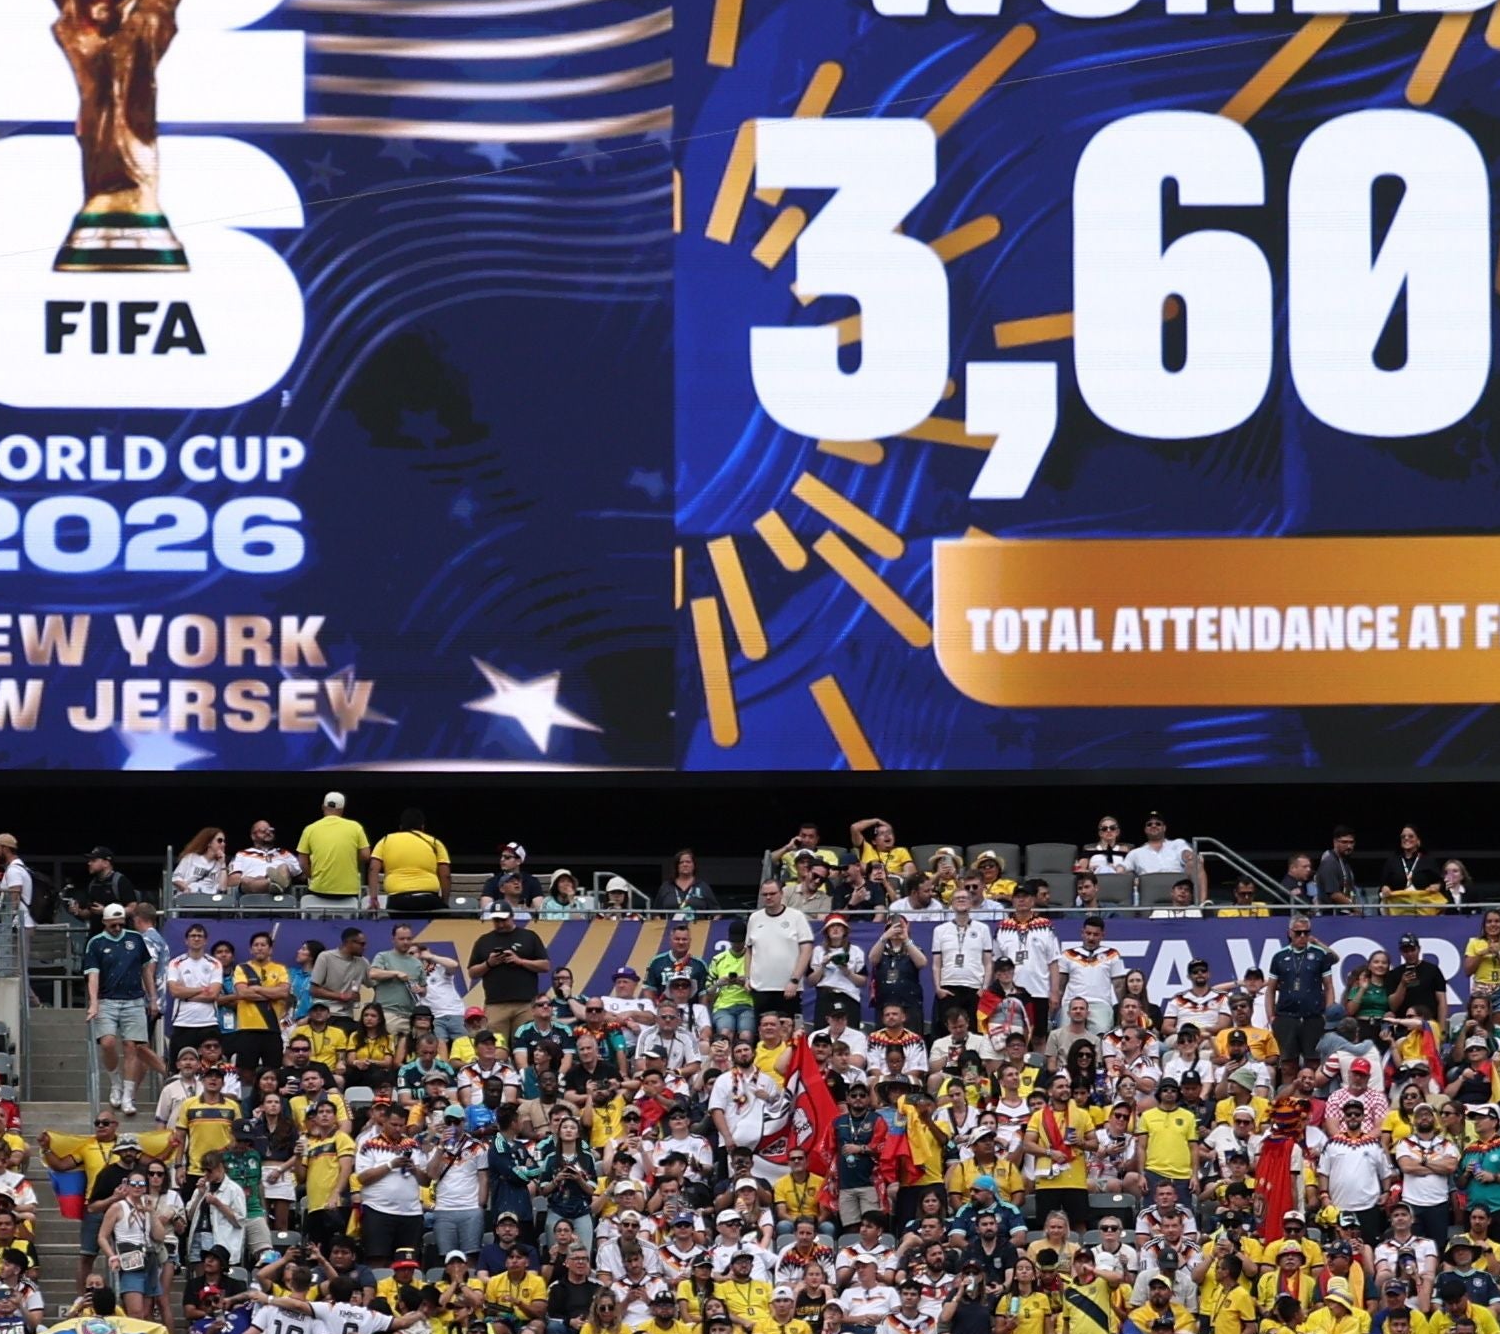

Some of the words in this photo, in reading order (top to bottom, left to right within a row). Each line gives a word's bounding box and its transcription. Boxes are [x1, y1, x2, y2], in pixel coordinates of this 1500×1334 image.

[45, 300, 206, 356] FIFA
[178, 435, 306, 483] CUP
[114, 613, 329, 668] YORK
[965, 606, 1104, 655] TOTAL
[1111, 604, 1400, 653] ATTENDANCE
[1407, 604, 1467, 651] AT
[67, 678, 376, 733] JERSEY
